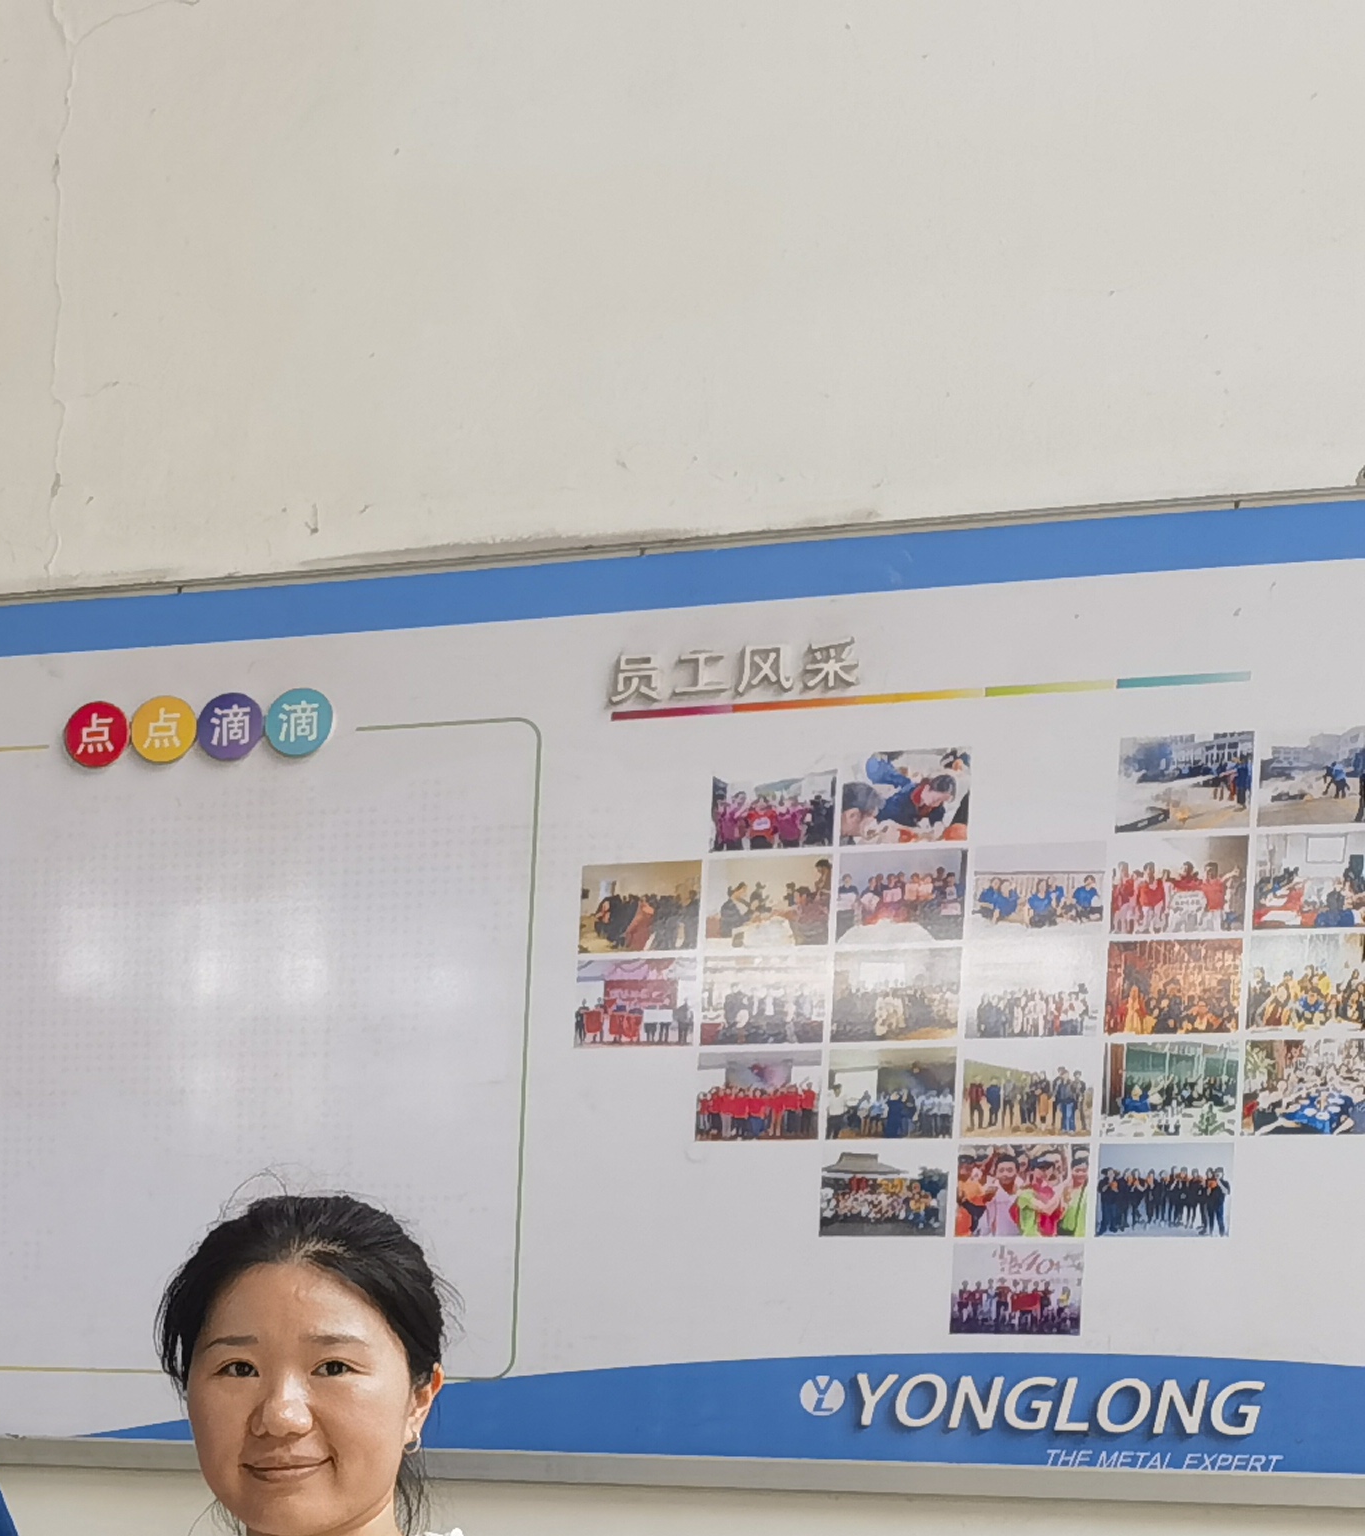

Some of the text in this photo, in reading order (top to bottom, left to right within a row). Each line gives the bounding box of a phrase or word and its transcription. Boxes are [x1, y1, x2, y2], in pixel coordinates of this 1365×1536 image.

[610, 637, 859, 704] 员工风采
[76, 699, 319, 755] 点点滴滴
[855, 1373, 1266, 1437] YONGLONG
[1095, 1451, 1175, 1471] METAL
[1182, 1453, 1284, 1473] EXPERT
